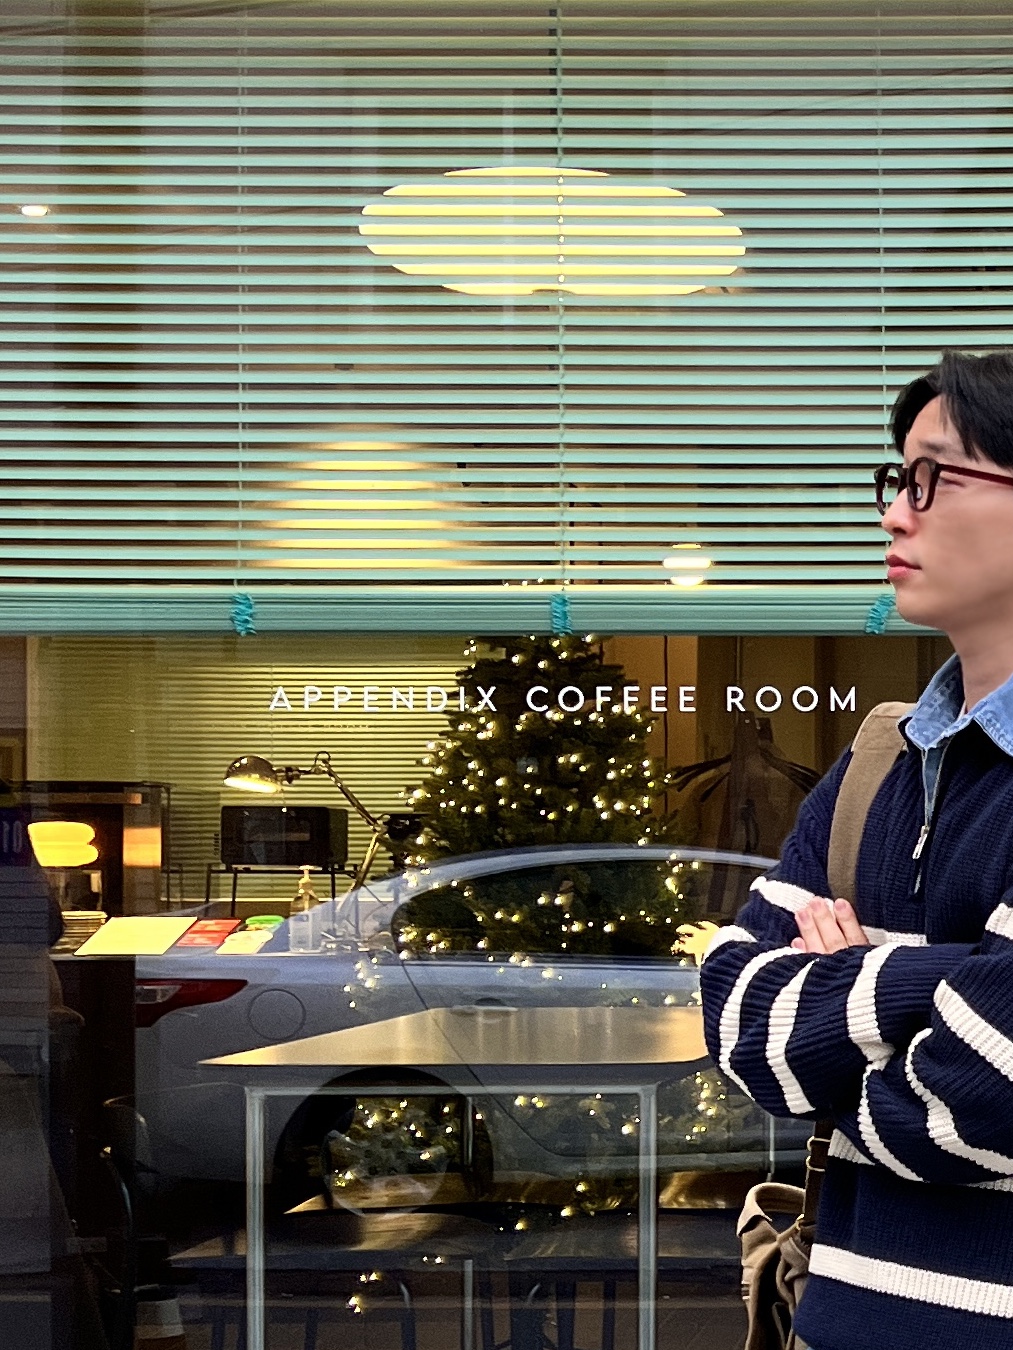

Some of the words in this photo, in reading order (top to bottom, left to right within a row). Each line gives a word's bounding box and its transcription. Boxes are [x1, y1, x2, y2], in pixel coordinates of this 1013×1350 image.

[268, 685, 497, 712] APPENDIX
[526, 685, 697, 712] COFFEE
[726, 685, 856, 712] ROOM
